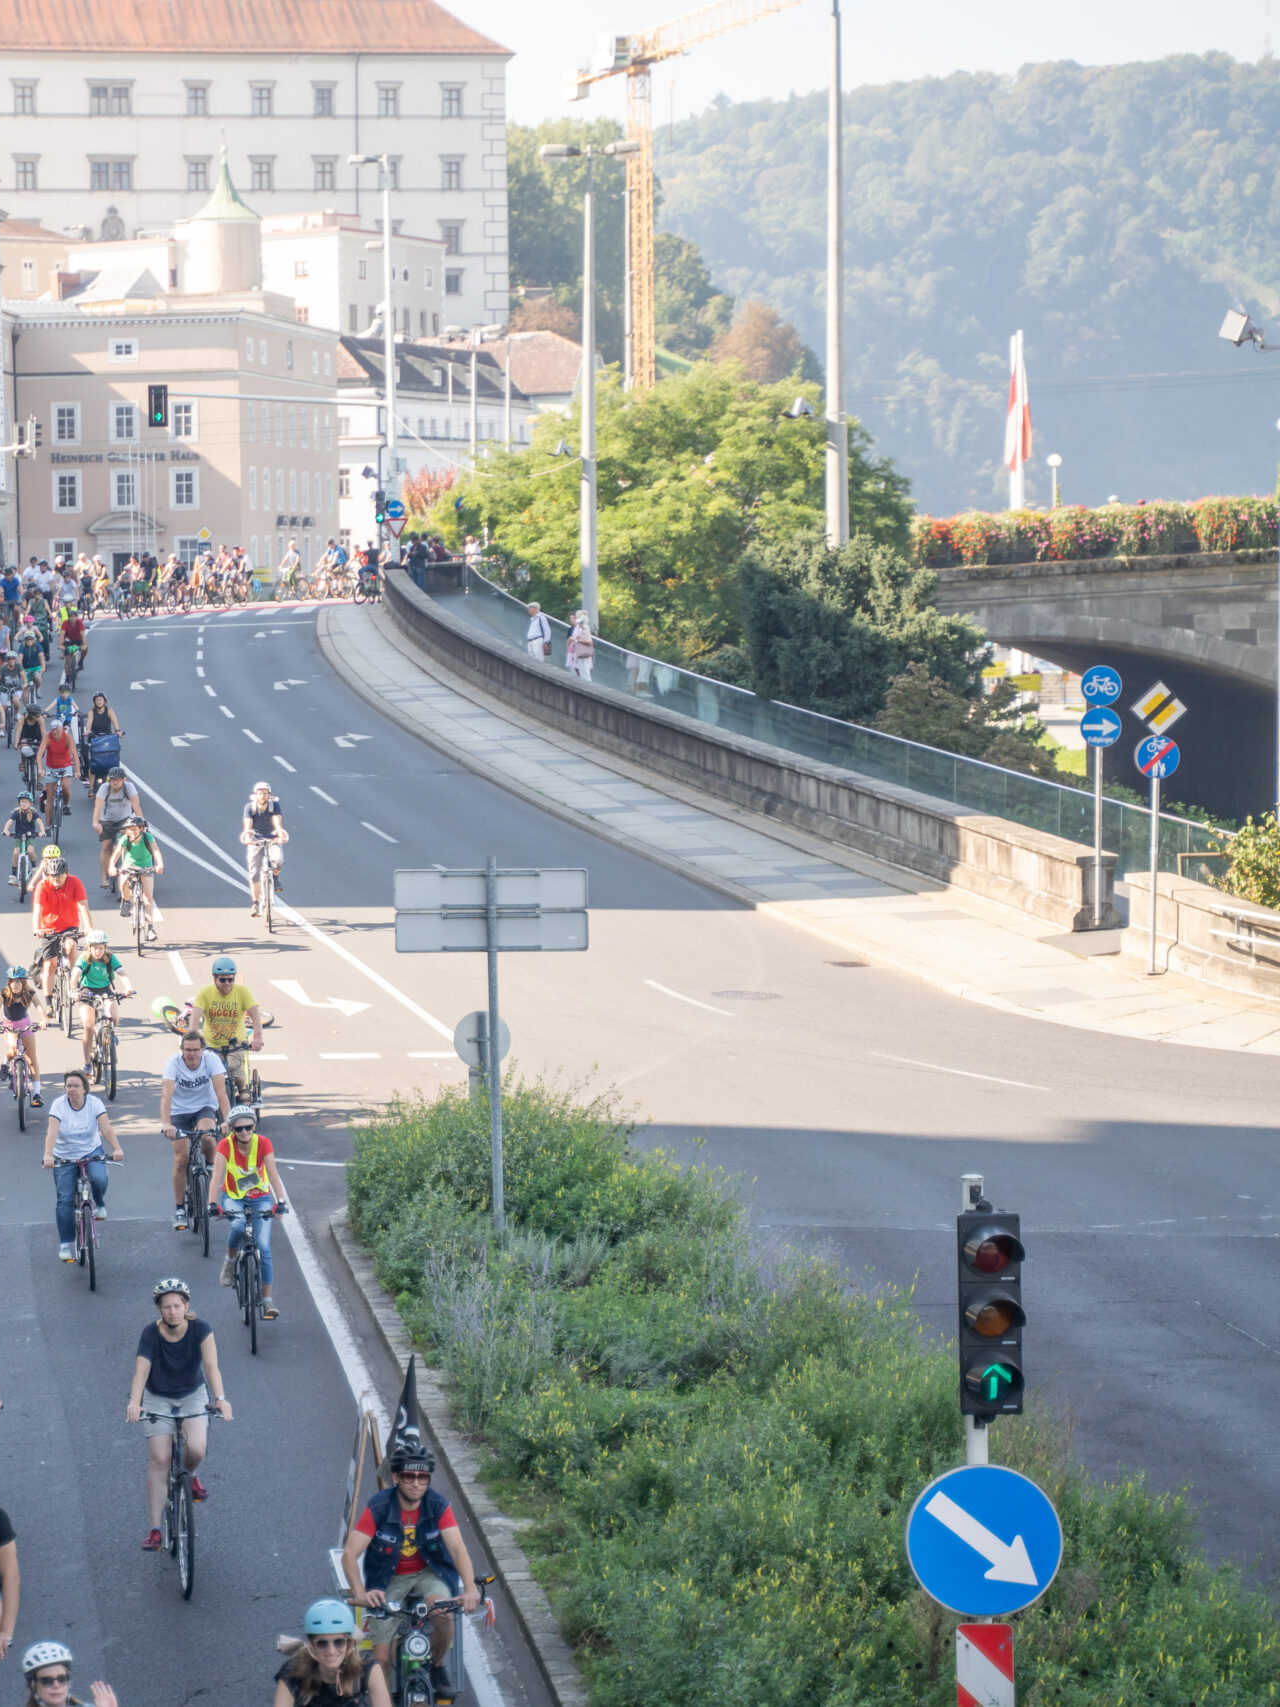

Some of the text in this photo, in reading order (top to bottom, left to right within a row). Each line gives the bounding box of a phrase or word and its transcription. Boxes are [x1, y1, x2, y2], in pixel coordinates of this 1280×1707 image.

[51, 452, 103, 464] HEINRICH
[170, 450, 200, 461] HAUS
[209, 1009, 239, 1017] BIGGIE
